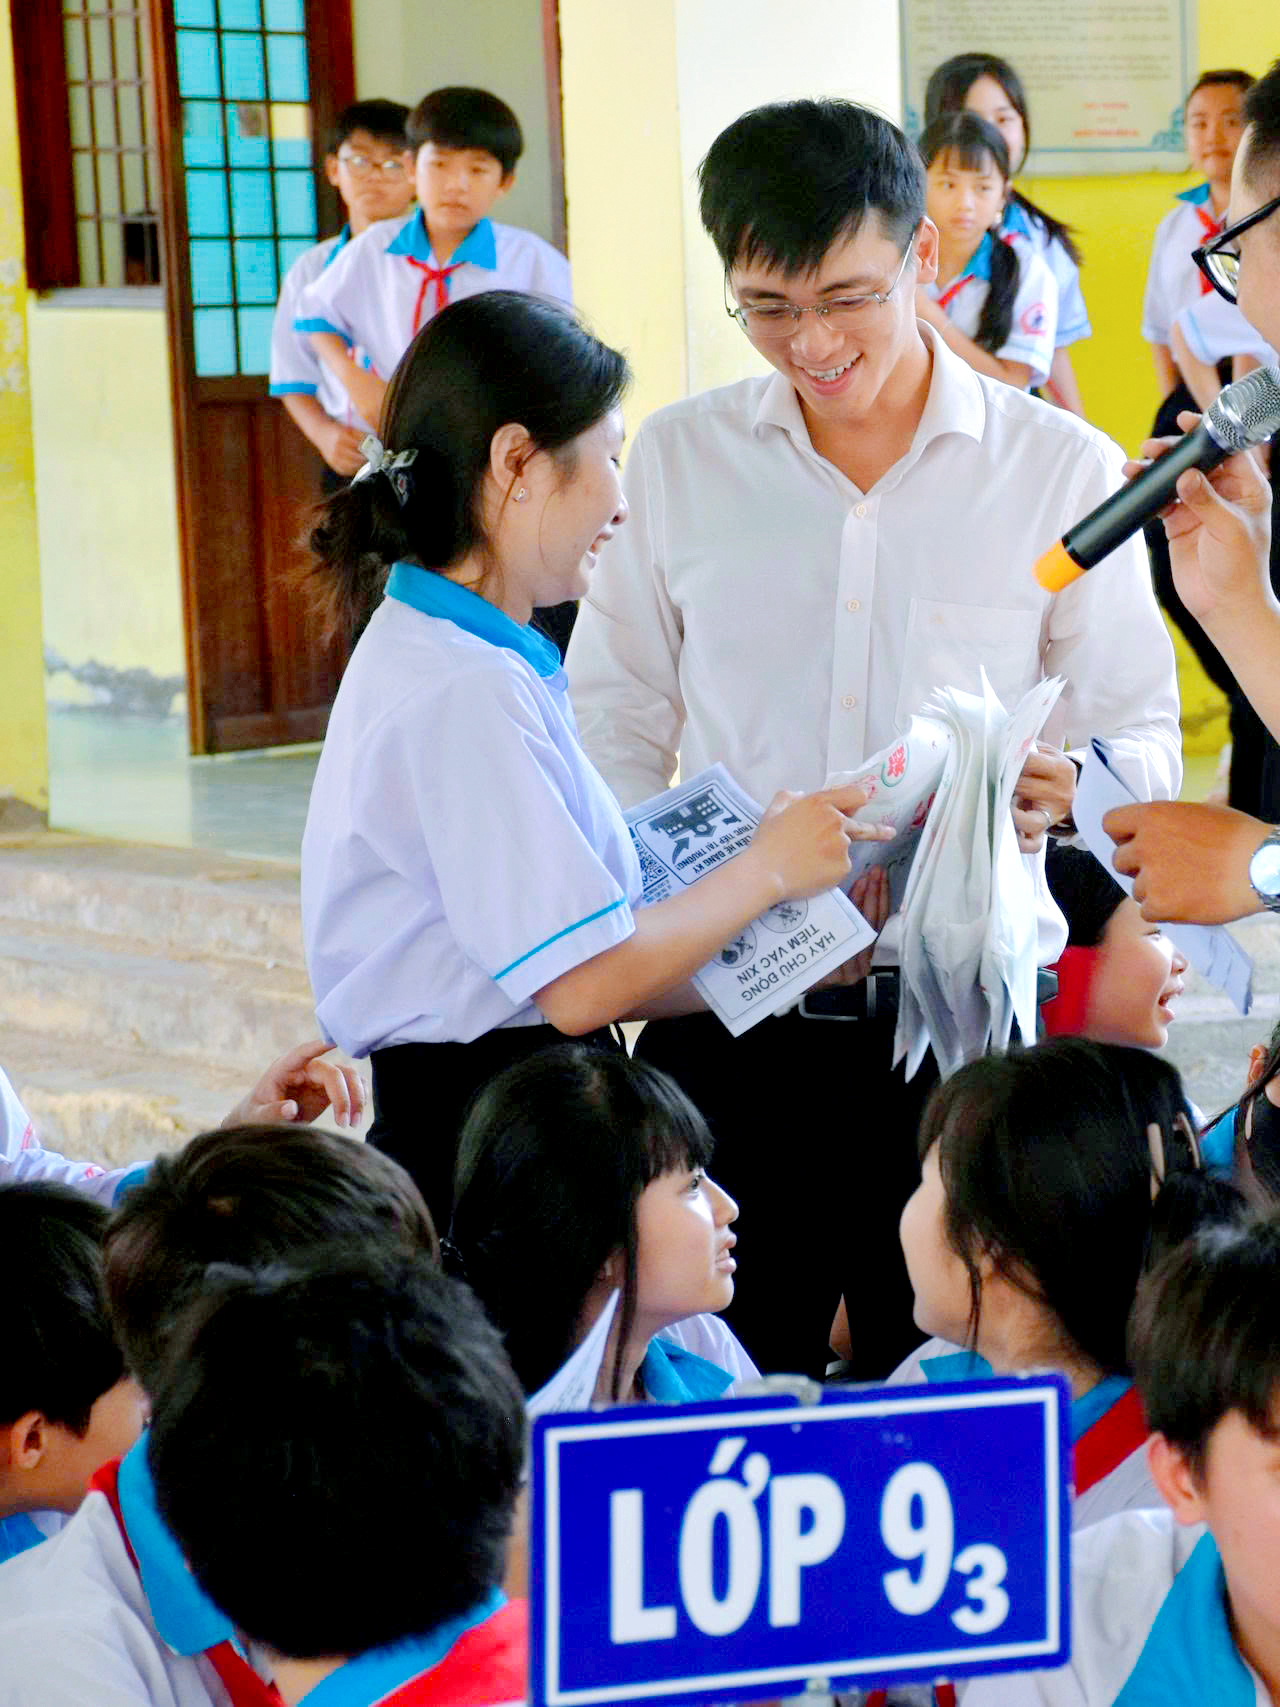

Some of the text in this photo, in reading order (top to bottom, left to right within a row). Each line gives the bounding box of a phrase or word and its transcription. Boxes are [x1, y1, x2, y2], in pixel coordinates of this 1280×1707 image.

[787, 923, 820, 950] TIÊM
[809, 931, 836, 957] HÃY
[737, 964, 760, 984] XIN
[779, 953, 807, 977] CHỦ
[609, 1437, 846, 1645] LỚP
